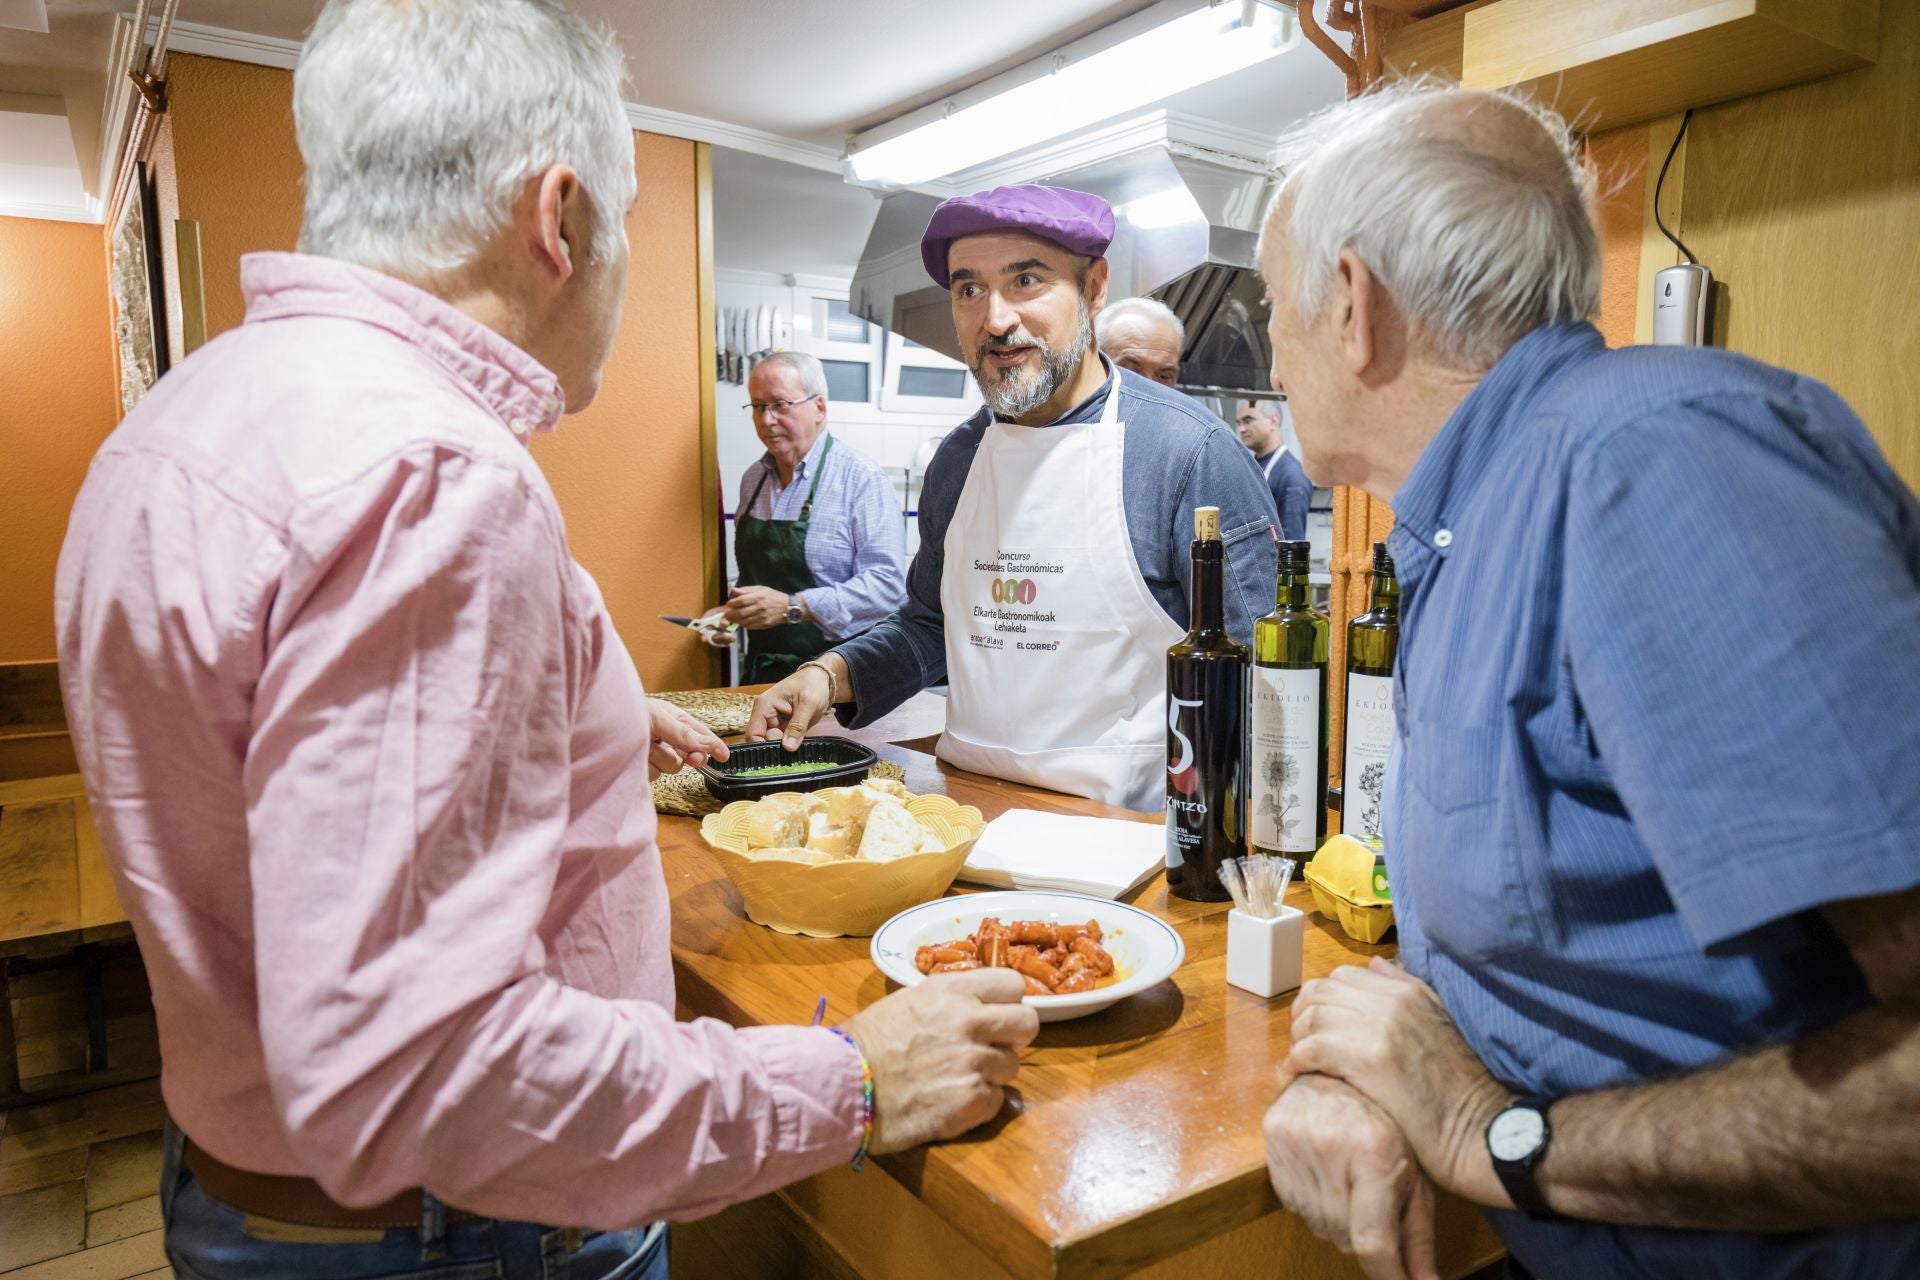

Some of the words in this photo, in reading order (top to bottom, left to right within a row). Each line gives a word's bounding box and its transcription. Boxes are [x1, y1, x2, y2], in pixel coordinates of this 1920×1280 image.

[1006, 562, 1064, 574] Gastronómicas
[973, 605, 997, 619] Elkarte
[997, 608, 1056, 622] Gastronomikoak
[994, 620, 1027, 633] Lehiaketa
[1016, 642, 1025, 650] EL
[1025, 642, 1057, 651] CORREO
[1167, 692, 1204, 775] 5
[1166, 795, 1208, 814] ZINTZO
